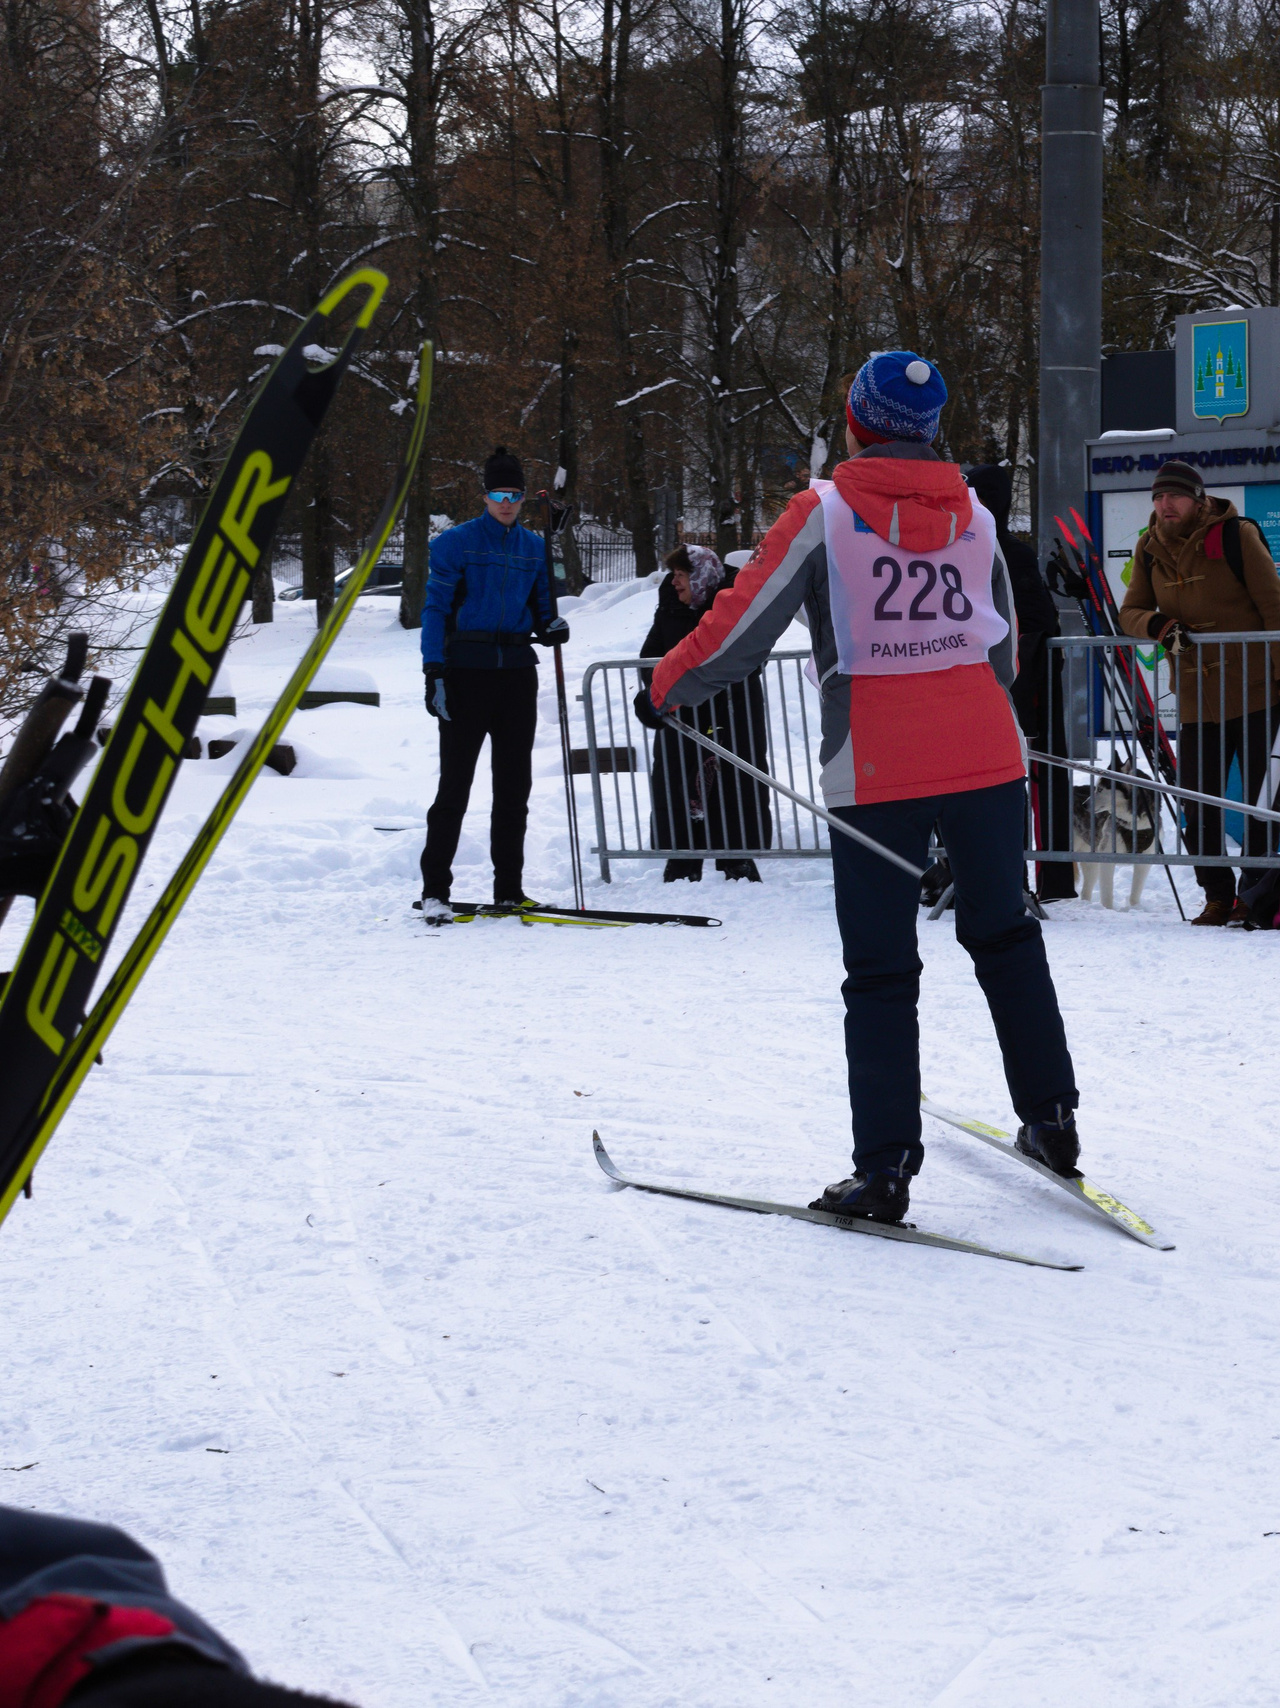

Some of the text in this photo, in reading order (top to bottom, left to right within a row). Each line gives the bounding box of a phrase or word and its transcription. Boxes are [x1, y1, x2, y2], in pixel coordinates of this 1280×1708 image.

[872, 555, 974, 623] 228
[871, 633, 969, 658] РАМЕНСКОЕ
[27, 450, 292, 1055] FISCHER
[834, 1216, 854, 1226] TISA
